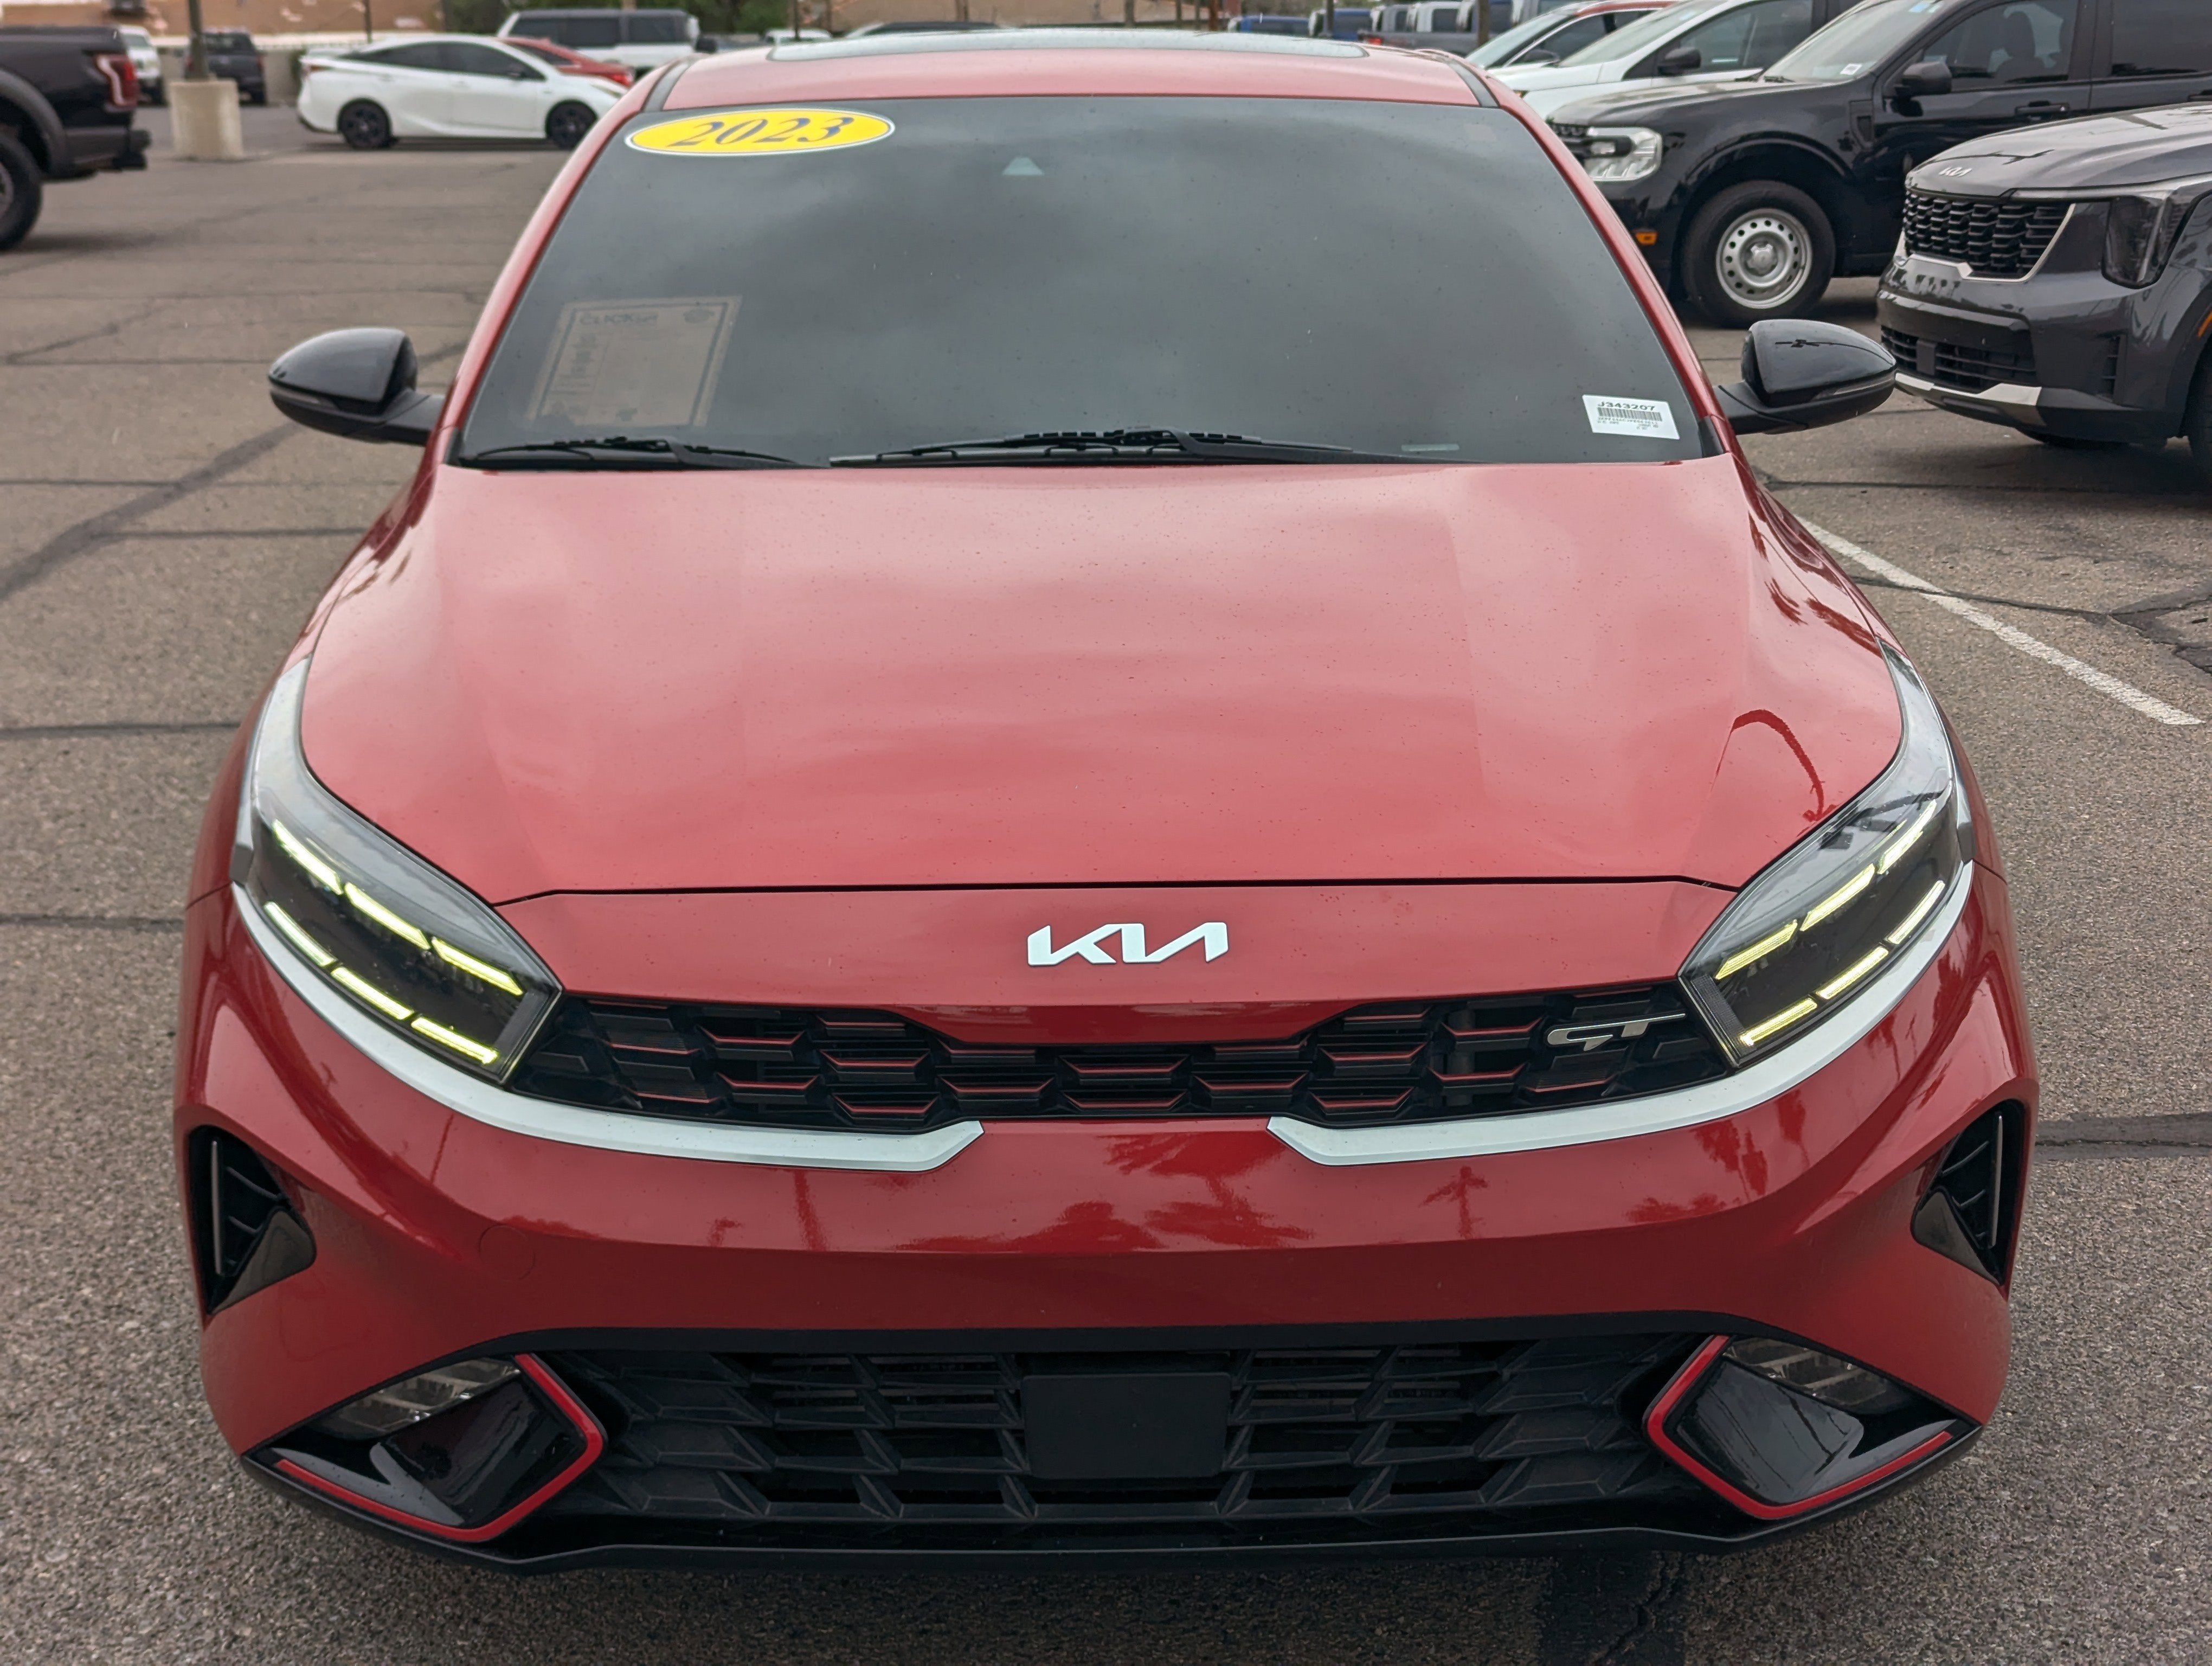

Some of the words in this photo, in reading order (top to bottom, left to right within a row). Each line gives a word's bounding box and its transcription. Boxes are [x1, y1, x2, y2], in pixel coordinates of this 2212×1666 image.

[666, 117, 854, 147] 2023
[1938, 165, 1972, 177] KIA
[1597, 401, 1655, 411] J343207
[1027, 922, 1229, 965] KIA
[1547, 1013, 1686, 1052] GT
